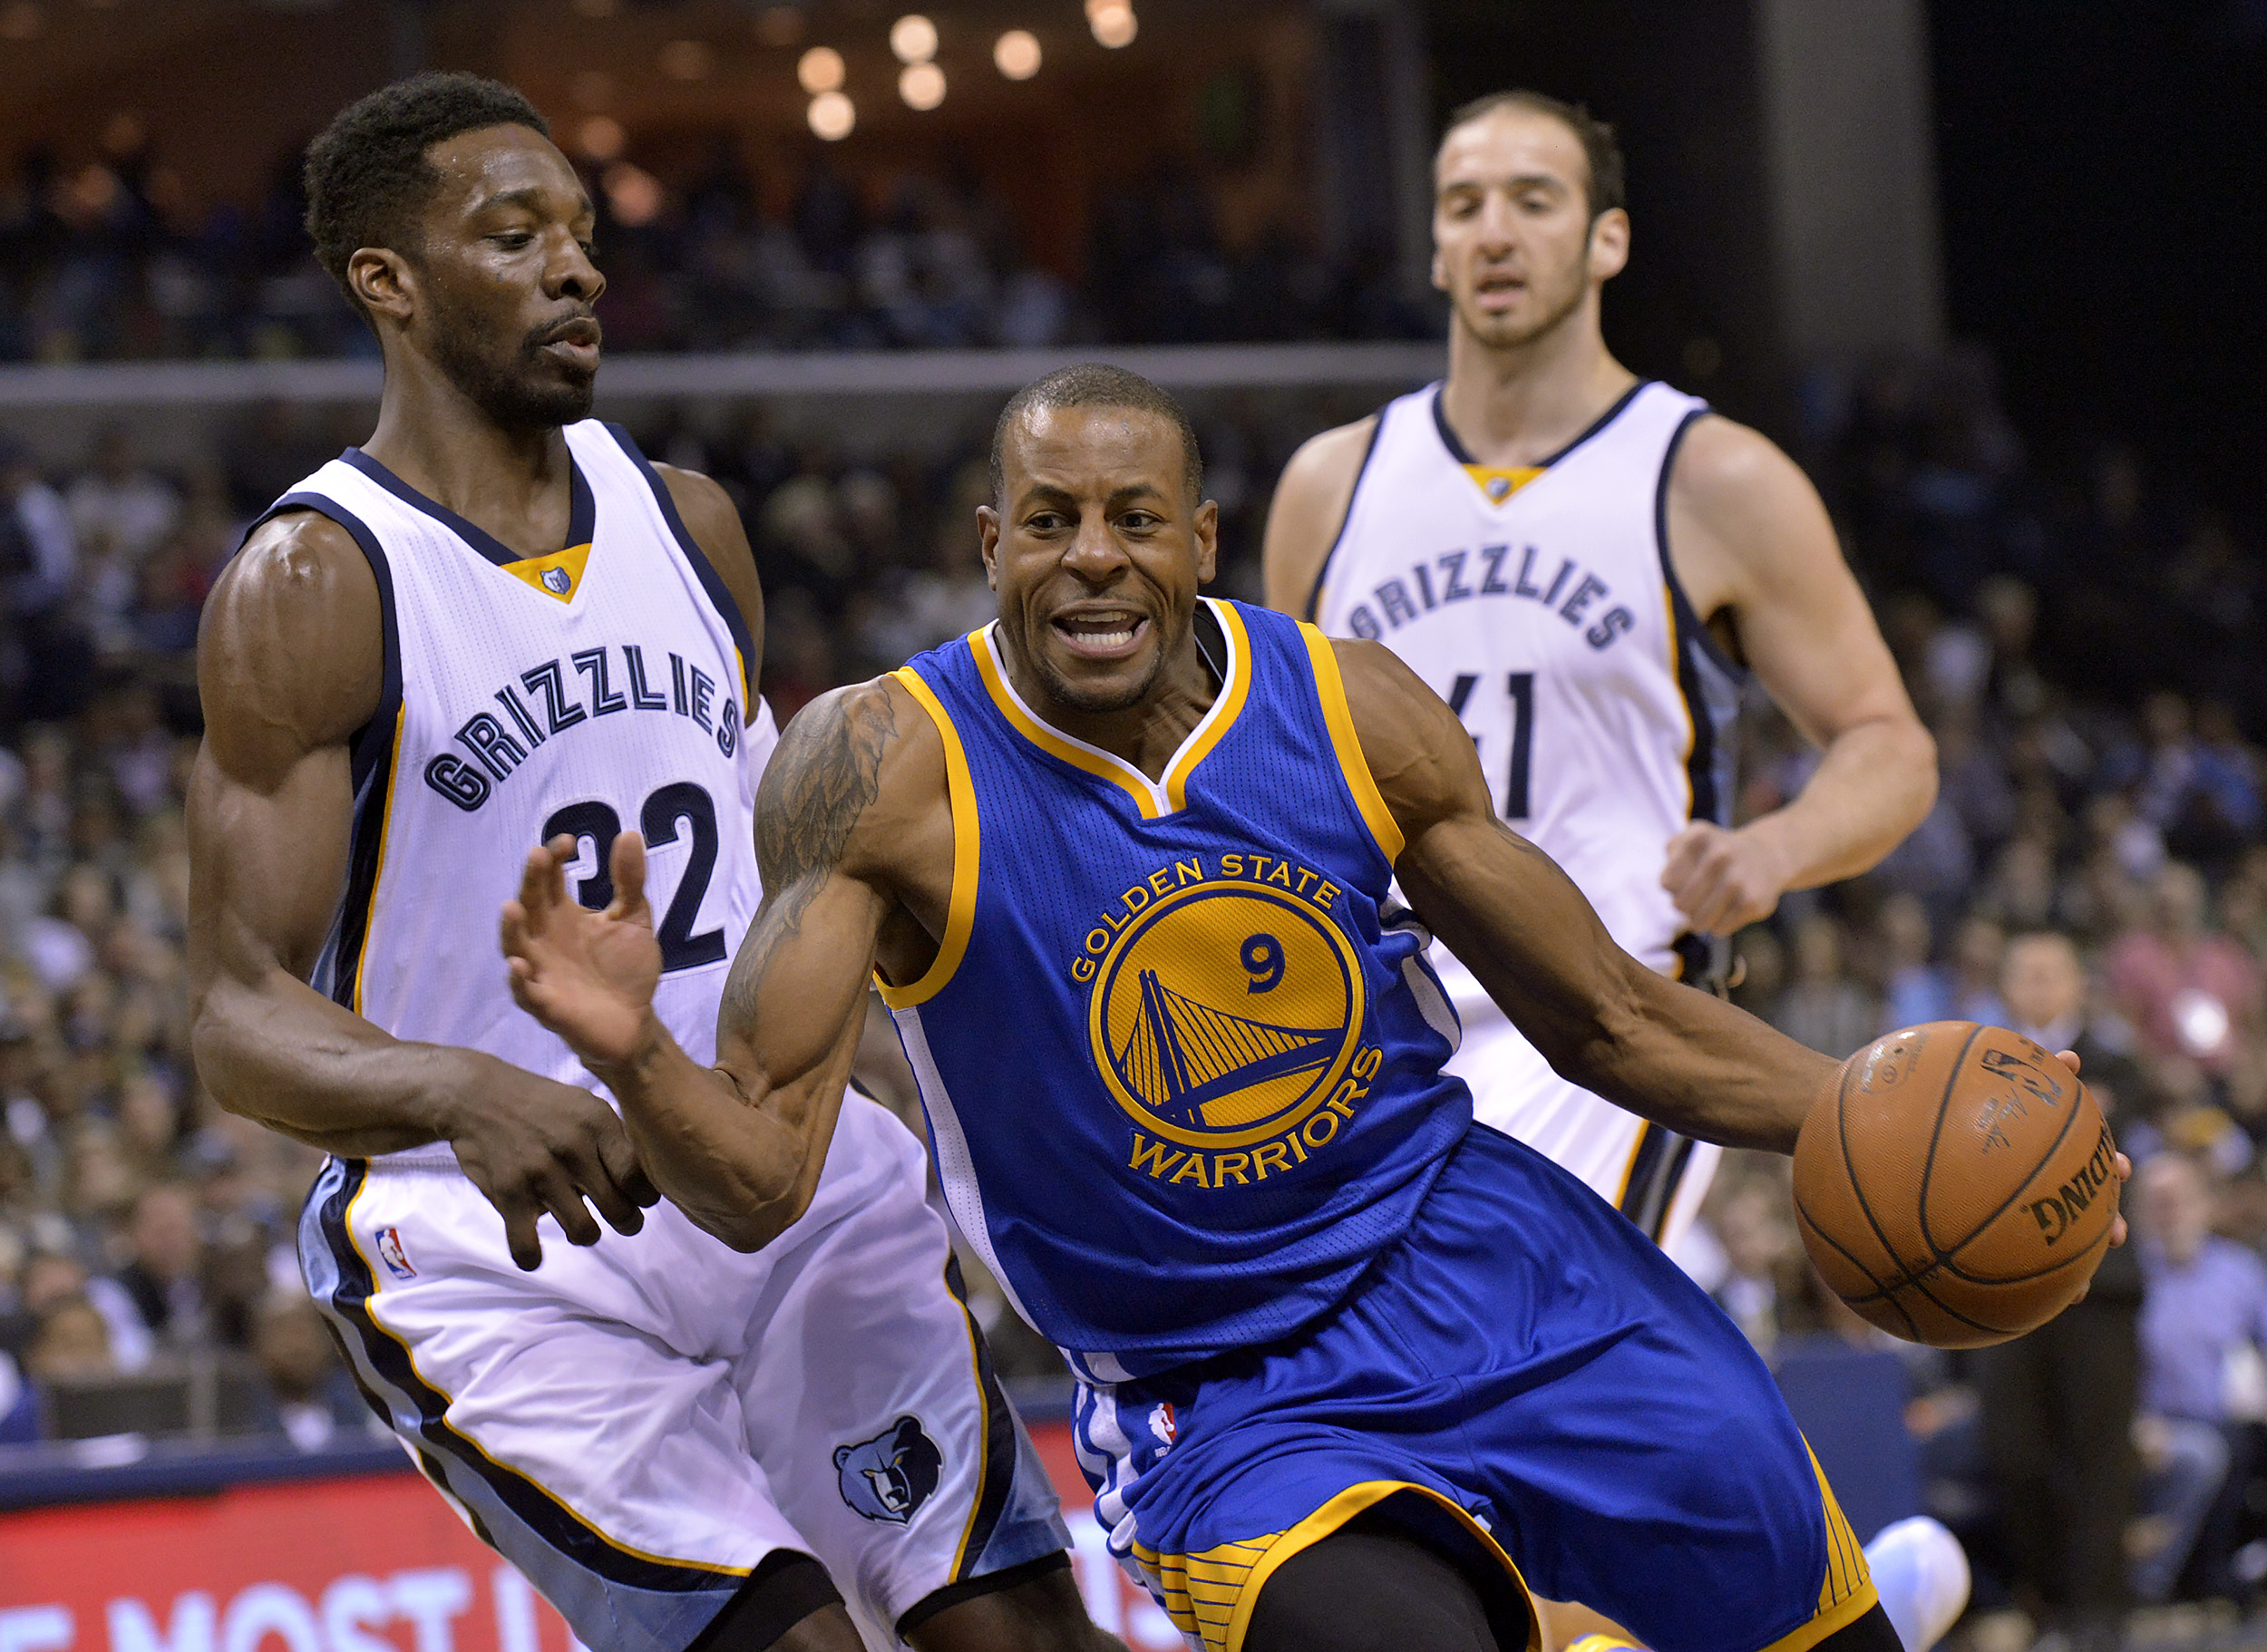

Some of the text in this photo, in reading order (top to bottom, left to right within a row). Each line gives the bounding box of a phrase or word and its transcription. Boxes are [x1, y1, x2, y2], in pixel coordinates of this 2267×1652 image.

[423, 645, 740, 812] GRIZZLIES
[1071, 854, 1342, 983] GOLDEN STATE
[1240, 933, 1286, 996] 9
[1128, 1045, 1383, 1189] WARRIORS
